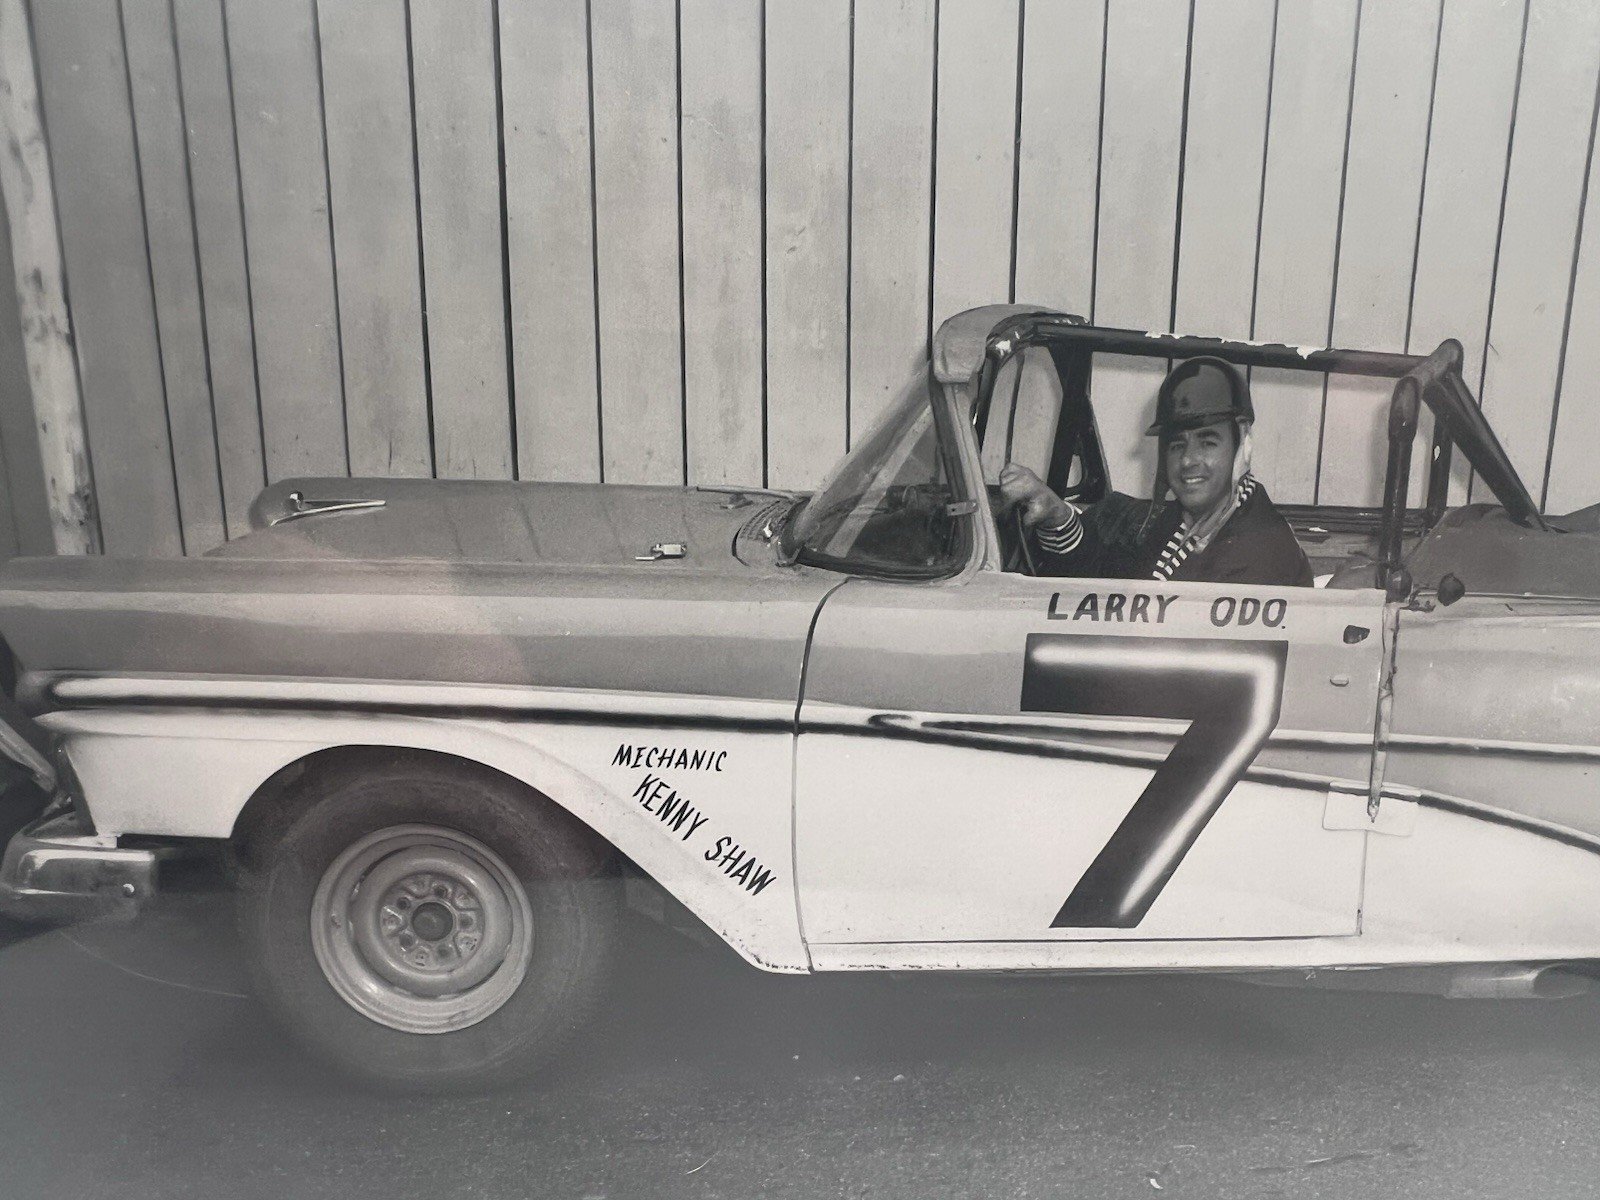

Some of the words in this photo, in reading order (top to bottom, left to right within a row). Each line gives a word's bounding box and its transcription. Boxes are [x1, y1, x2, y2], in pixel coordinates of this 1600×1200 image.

[1047, 592, 1180, 624] LARRY
[611, 743, 727, 772] MECHANIC
[1020, 632, 1289, 929] 7
[632, 773, 709, 841] KENNY
[704, 836, 777, 896] SHAW
